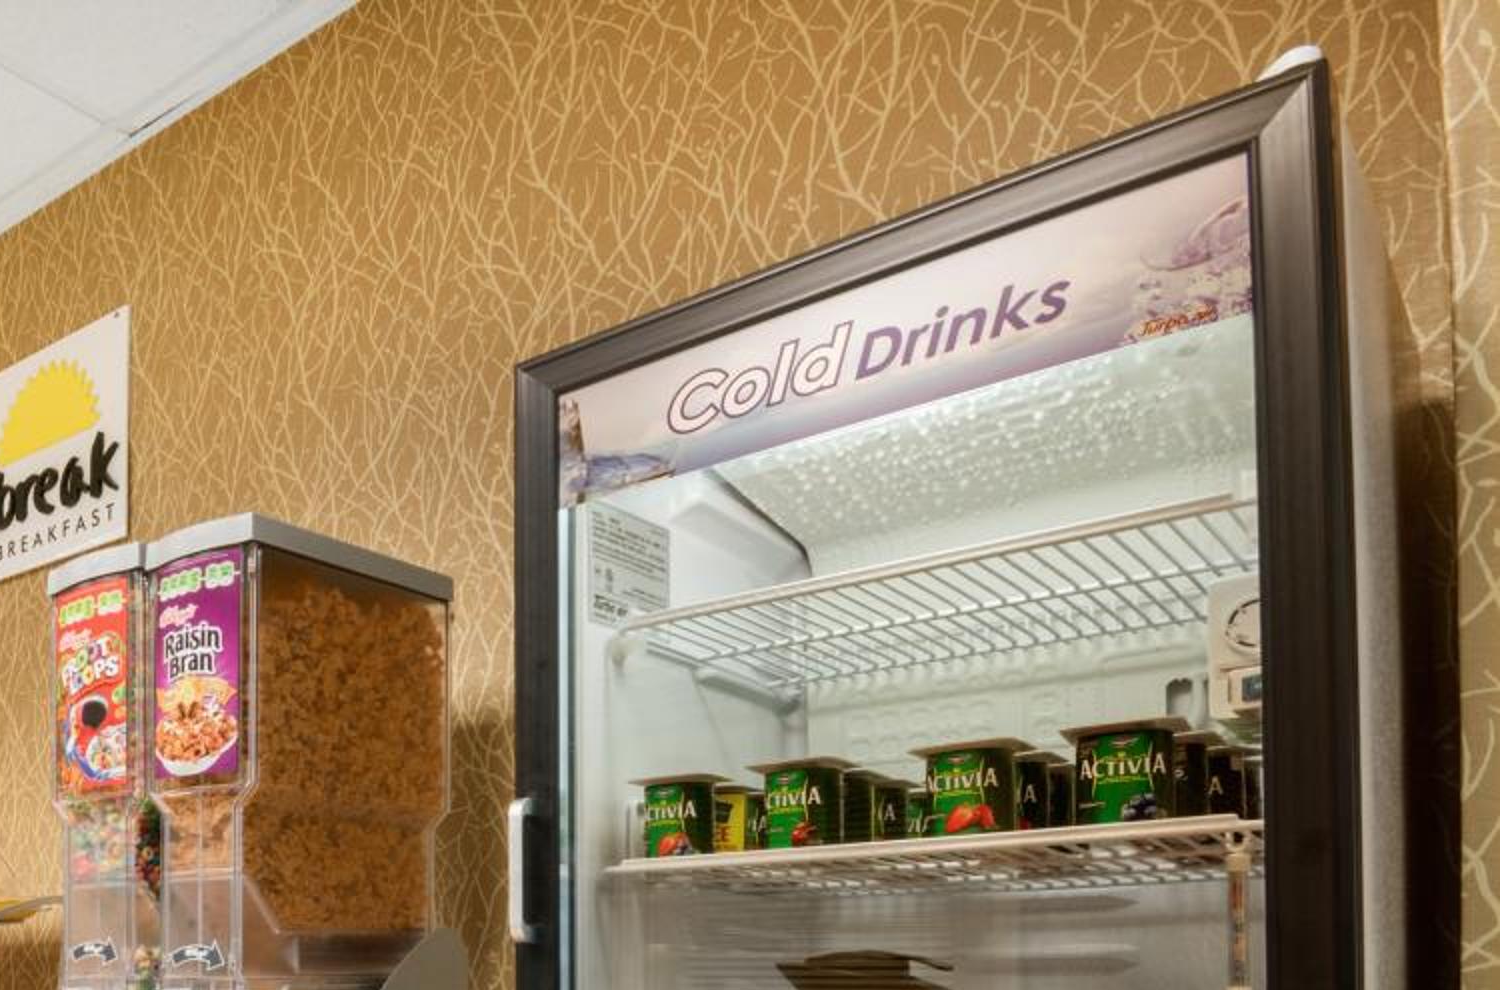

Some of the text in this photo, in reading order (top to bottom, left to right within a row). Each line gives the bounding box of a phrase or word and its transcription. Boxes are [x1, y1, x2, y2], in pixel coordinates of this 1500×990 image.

[668, 281, 1070, 434] Cold Drinks
[164, 624, 220, 658] Raisin
[169, 652, 213, 679] Bran
[1079, 752, 1166, 780] ACTIVIA
